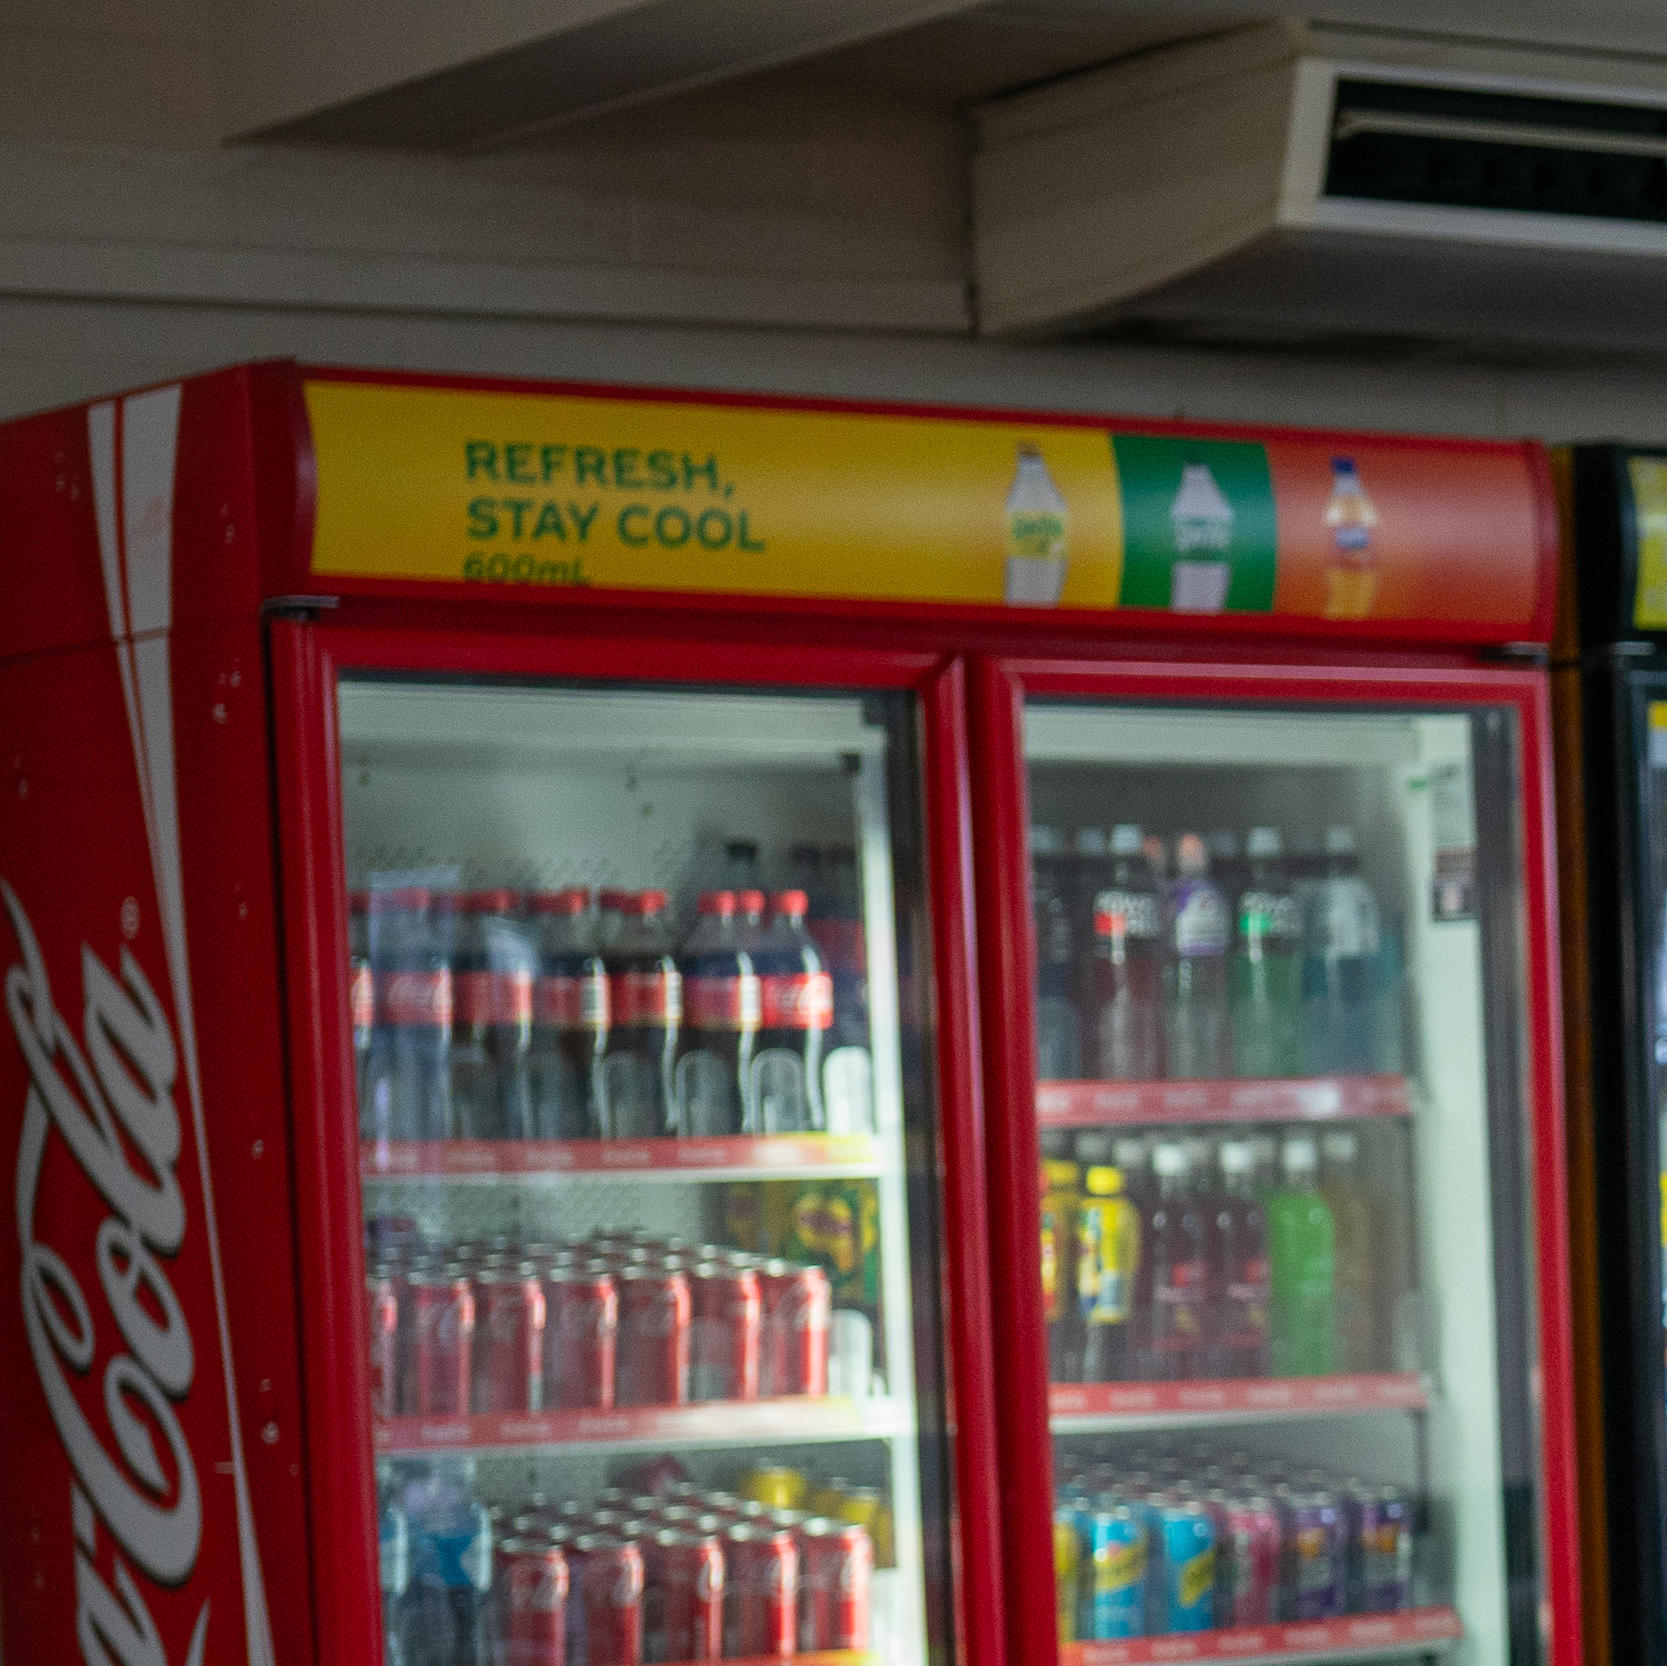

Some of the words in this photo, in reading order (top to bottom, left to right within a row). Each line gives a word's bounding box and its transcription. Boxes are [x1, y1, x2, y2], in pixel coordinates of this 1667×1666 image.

[464, 438, 736, 500] REFRESH,
[466, 496, 600, 546] STAY
[615, 503, 767, 554] COOL
